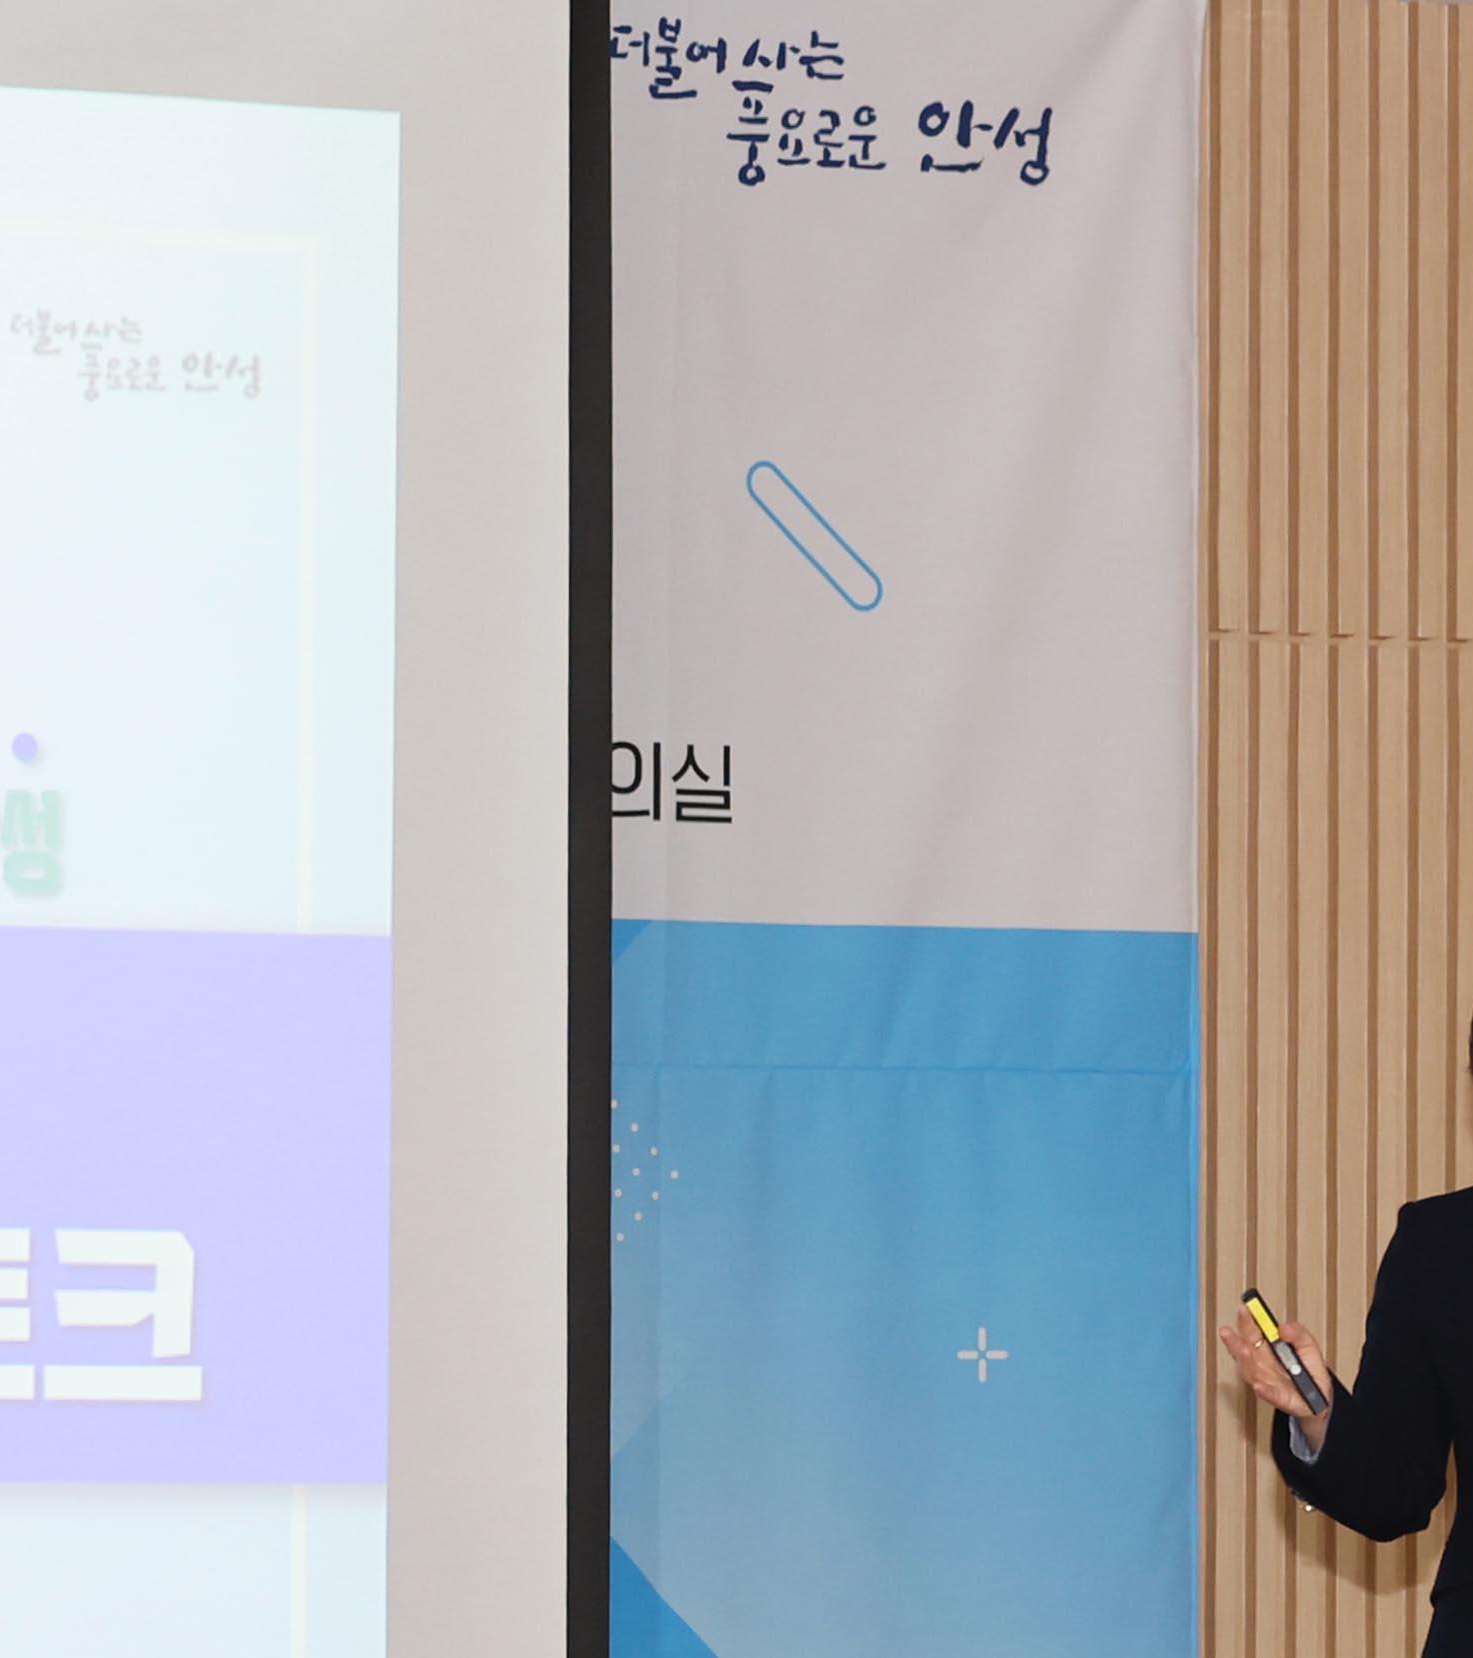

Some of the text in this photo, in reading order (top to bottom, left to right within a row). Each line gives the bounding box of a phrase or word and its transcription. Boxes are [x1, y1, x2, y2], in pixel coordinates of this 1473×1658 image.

[610, 17, 844, 98] 더불어 사는
[727, 81, 1053, 186] 풍요로운 안성
[9, 308, 143, 356] 더불어 사는
[77, 341, 262, 402] 풍요로운 안성
[611, 740, 732, 824] 의실
